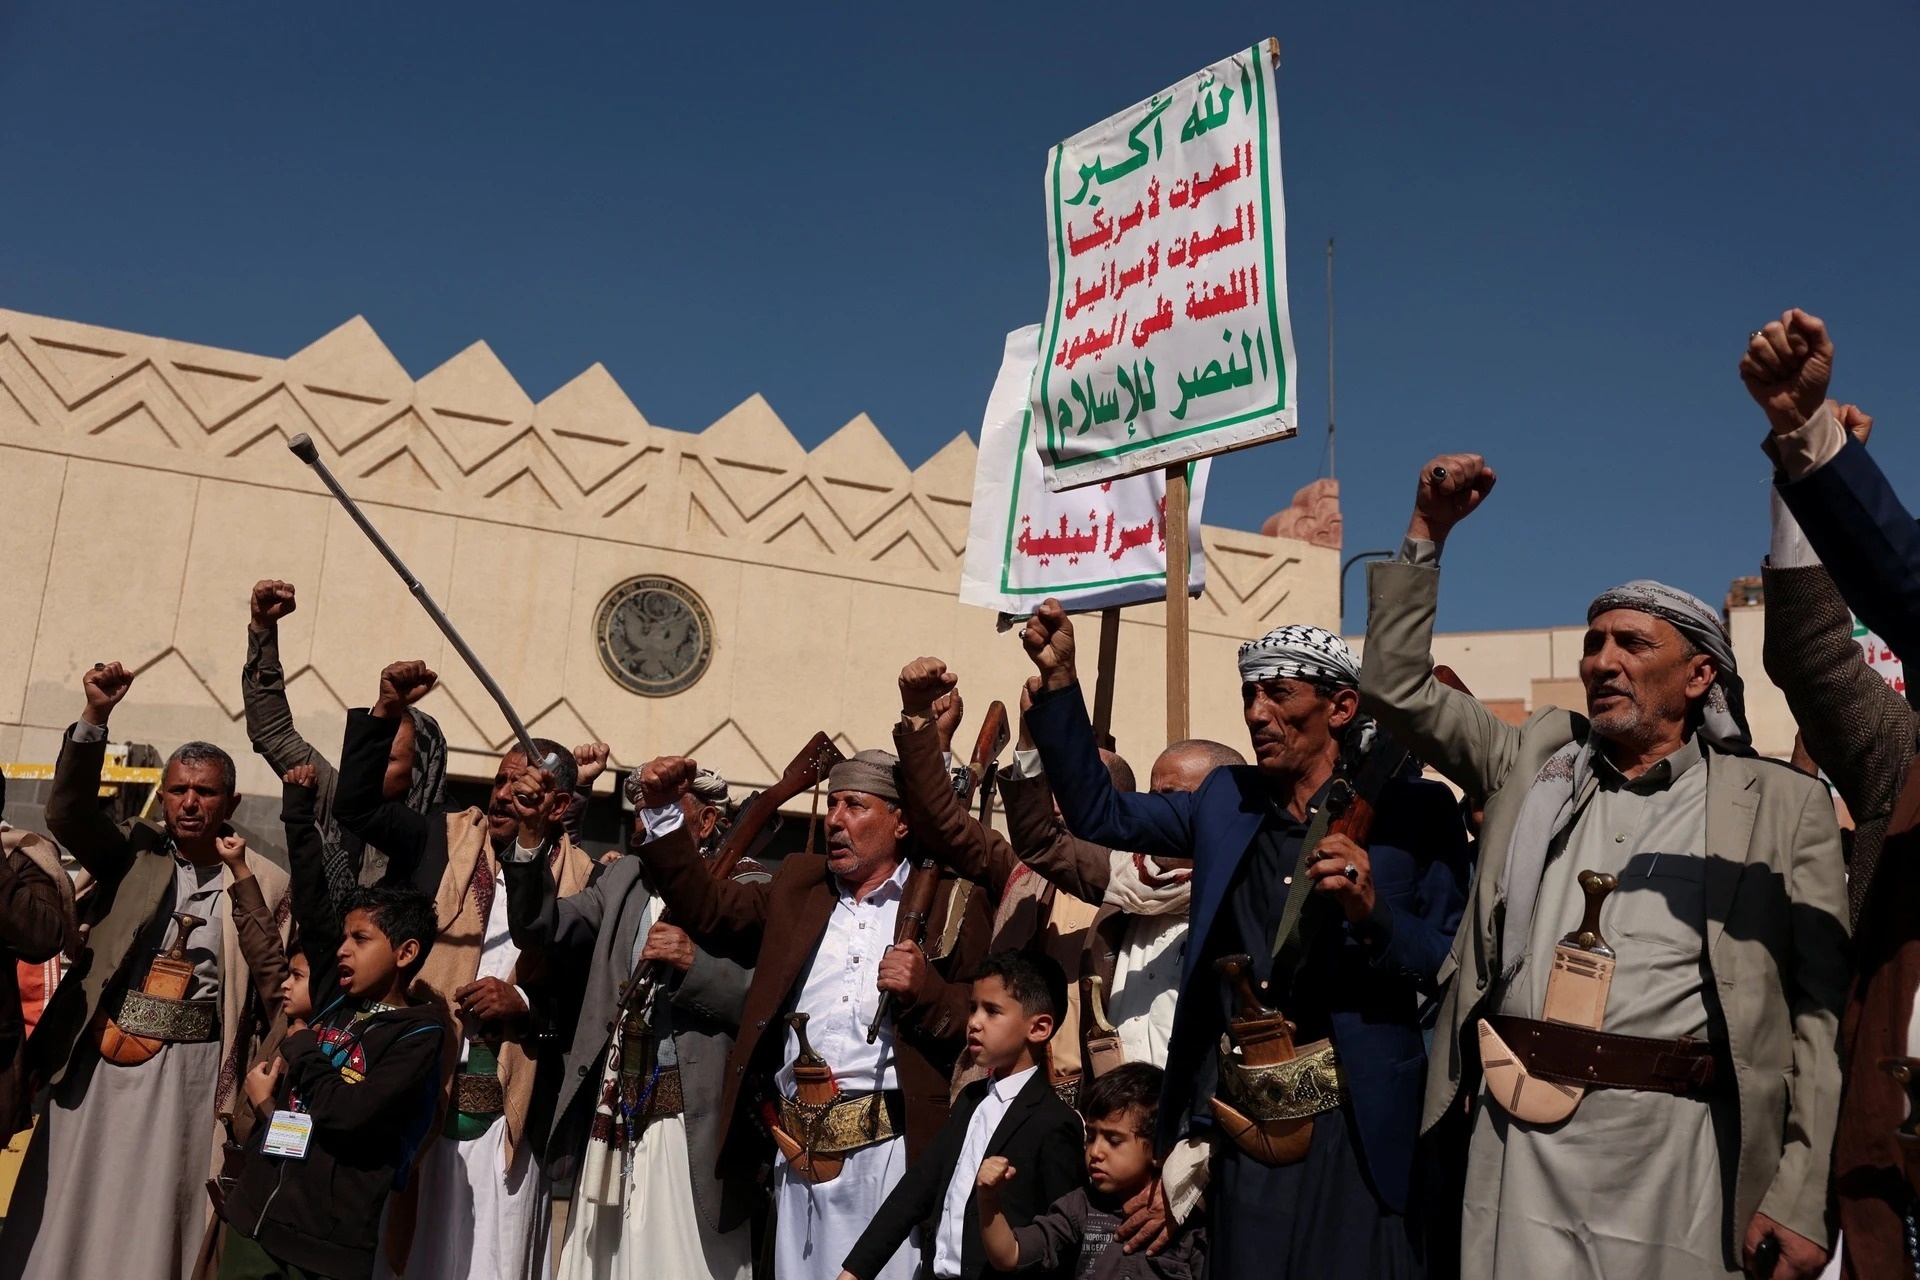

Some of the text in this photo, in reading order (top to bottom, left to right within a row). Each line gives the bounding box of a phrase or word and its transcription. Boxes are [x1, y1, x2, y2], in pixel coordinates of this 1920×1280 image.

[1064, 63, 1253, 206] الله أكبر
[1067, 139, 1253, 257] الموت لأمريكا
[1055, 262, 1259, 371] اللعنة على اليهود
[1065, 200, 1256, 320] الموت لإسرائيل
[1057, 326, 1269, 450] النصر للإسلام
